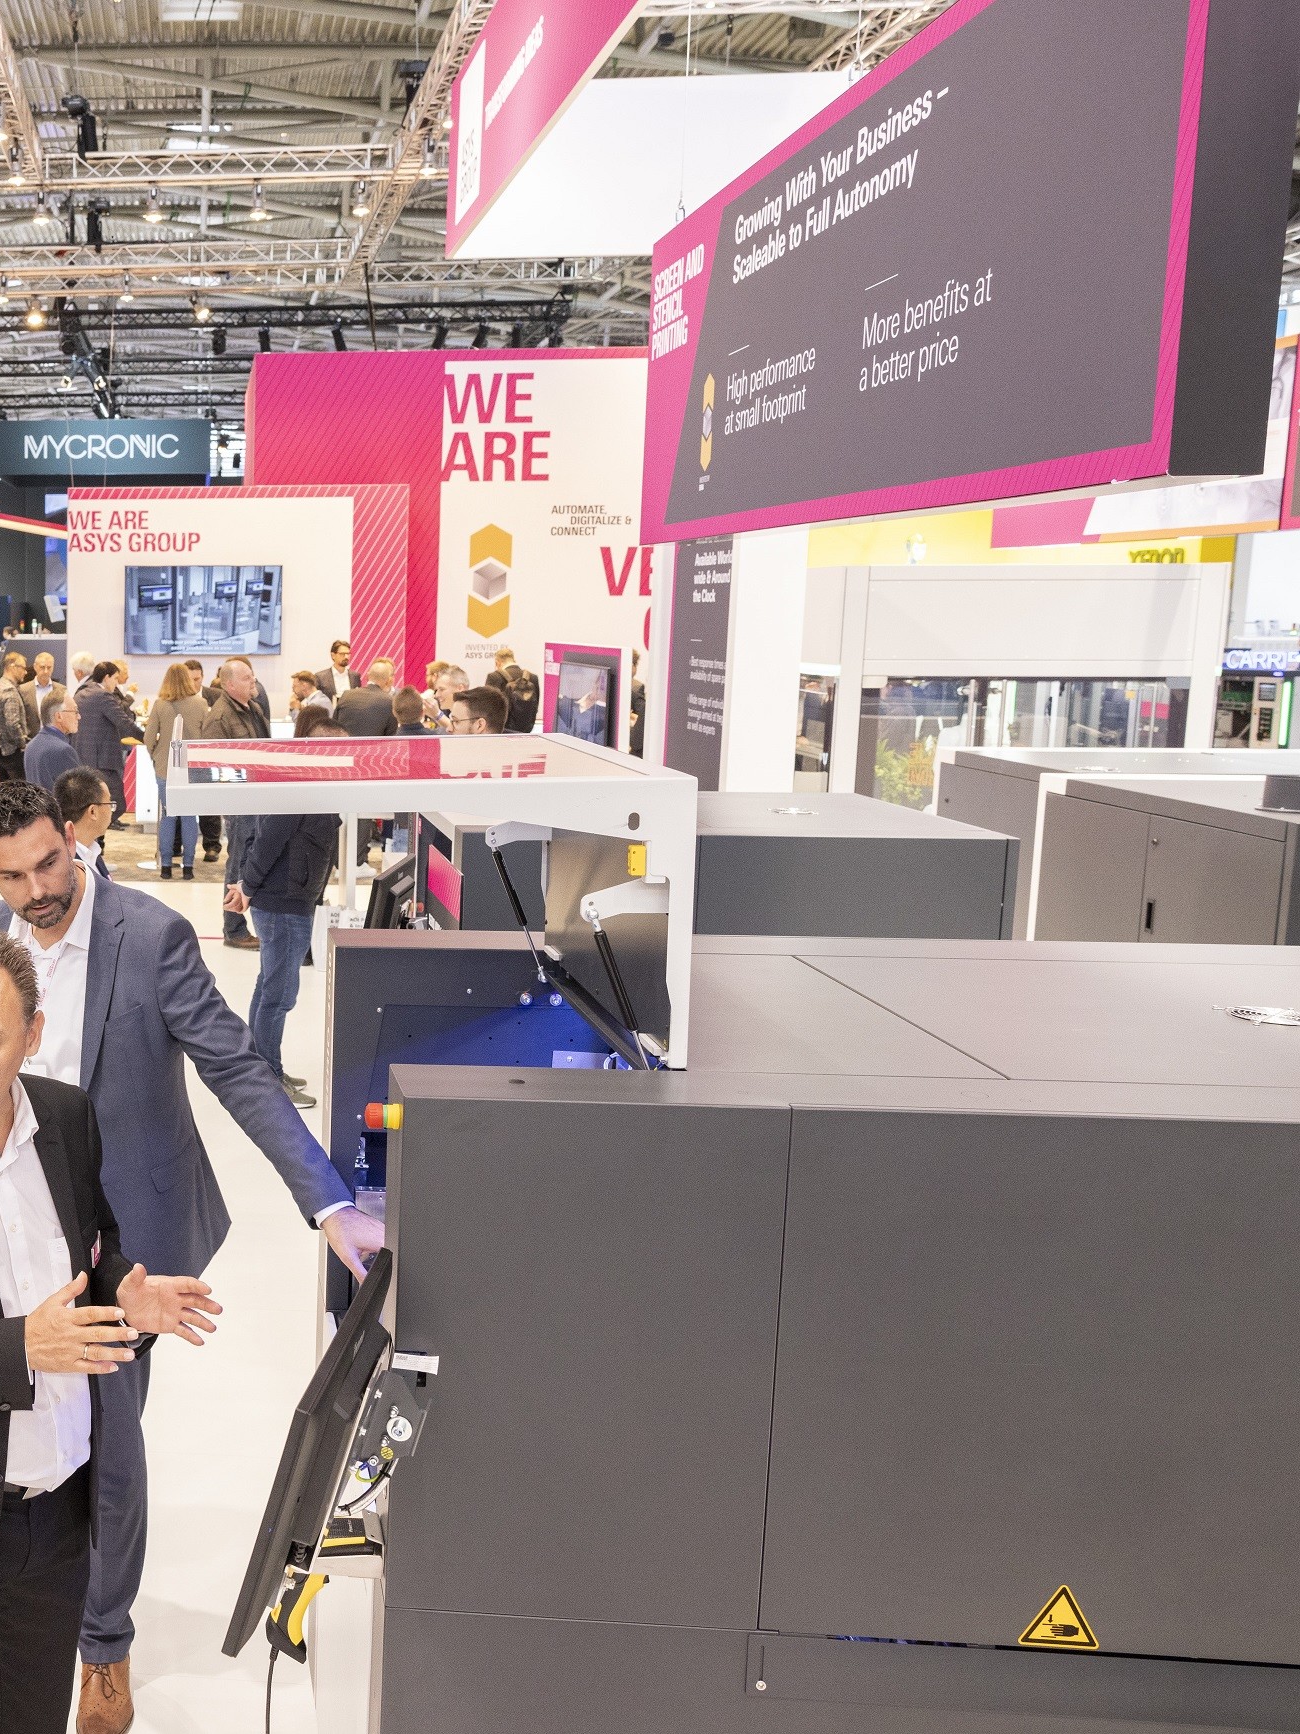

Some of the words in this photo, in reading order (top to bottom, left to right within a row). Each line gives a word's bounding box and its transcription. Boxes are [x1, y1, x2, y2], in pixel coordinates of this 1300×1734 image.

[734, 193, 782, 244] Growing
[785, 165, 816, 212] With
[820, 144, 853, 188] Your
[856, 89, 933, 165] Business
[732, 229, 786, 284] Scaleable
[789, 223, 802, 251] to
[805, 195, 830, 241] Full
[832, 148, 919, 226] Autonomy
[653, 256, 685, 303] SCREEN
[684, 243, 705, 283] AND
[652, 287, 684, 333] STENCIL
[862, 312, 900, 349] More
[904, 279, 969, 334] benefits
[974, 268, 993, 307] at
[651, 315, 689, 362] PRINTING
[859, 367, 867, 391] a
[871, 352, 915, 388] better
[917, 331, 959, 382] price
[444, 371, 534, 425] WE
[726, 370, 748, 404] High
[750, 347, 816, 399] performance
[724, 408, 734, 435] at
[735, 399, 761, 430] small
[762, 384, 807, 424] footprint
[23, 433, 180, 459] MYCRONIC
[442, 430, 550, 482] ARE
[68, 511, 102, 530] WE
[108, 511, 149, 530] ARE
[551, 505, 607, 515] AUTOMATE,
[551, 527, 596, 536] CONNECT
[570, 516, 622, 525] DIGITALIZE
[625, 516, 632, 525] &
[68, 533, 122, 552] ASYS
[128, 533, 201, 552] GROUP
